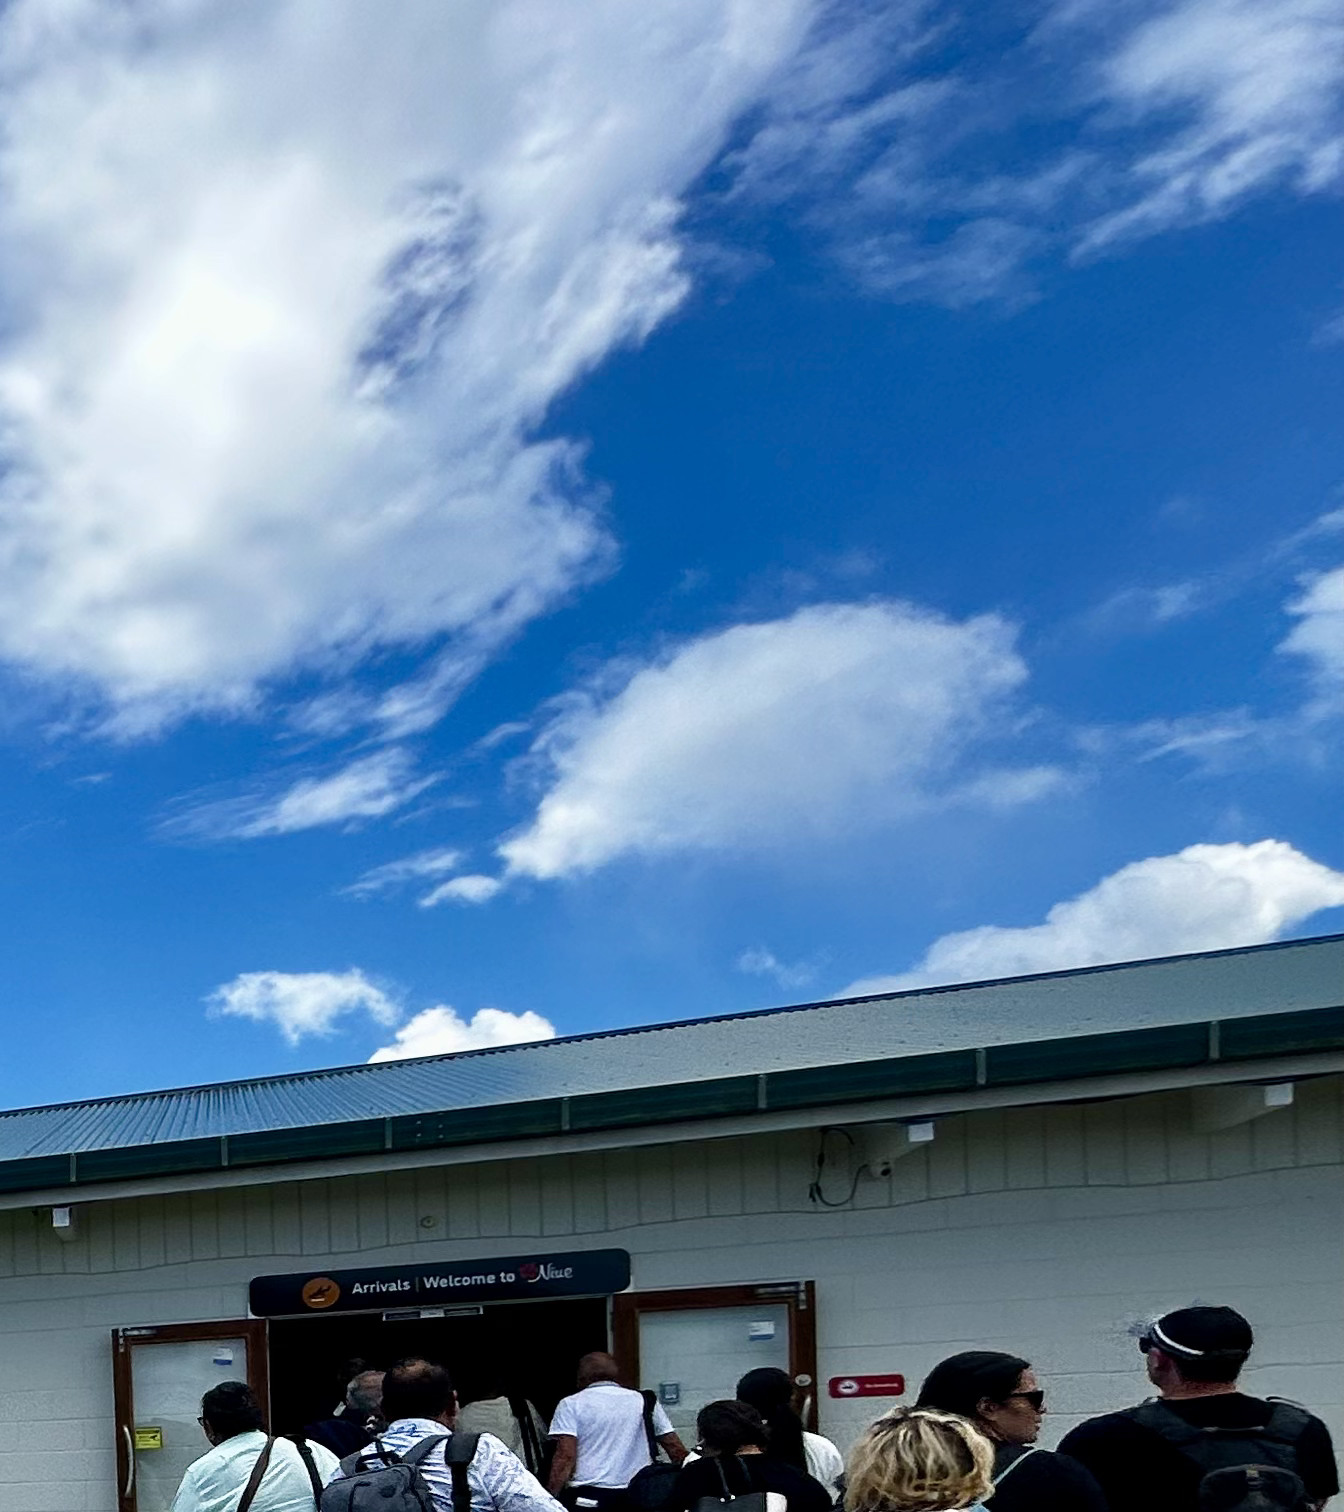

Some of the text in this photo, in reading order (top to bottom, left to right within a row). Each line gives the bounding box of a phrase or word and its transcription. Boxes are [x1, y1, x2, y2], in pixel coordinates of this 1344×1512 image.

[351, 1263, 573, 1294] Arrivals Welcome to Niue
